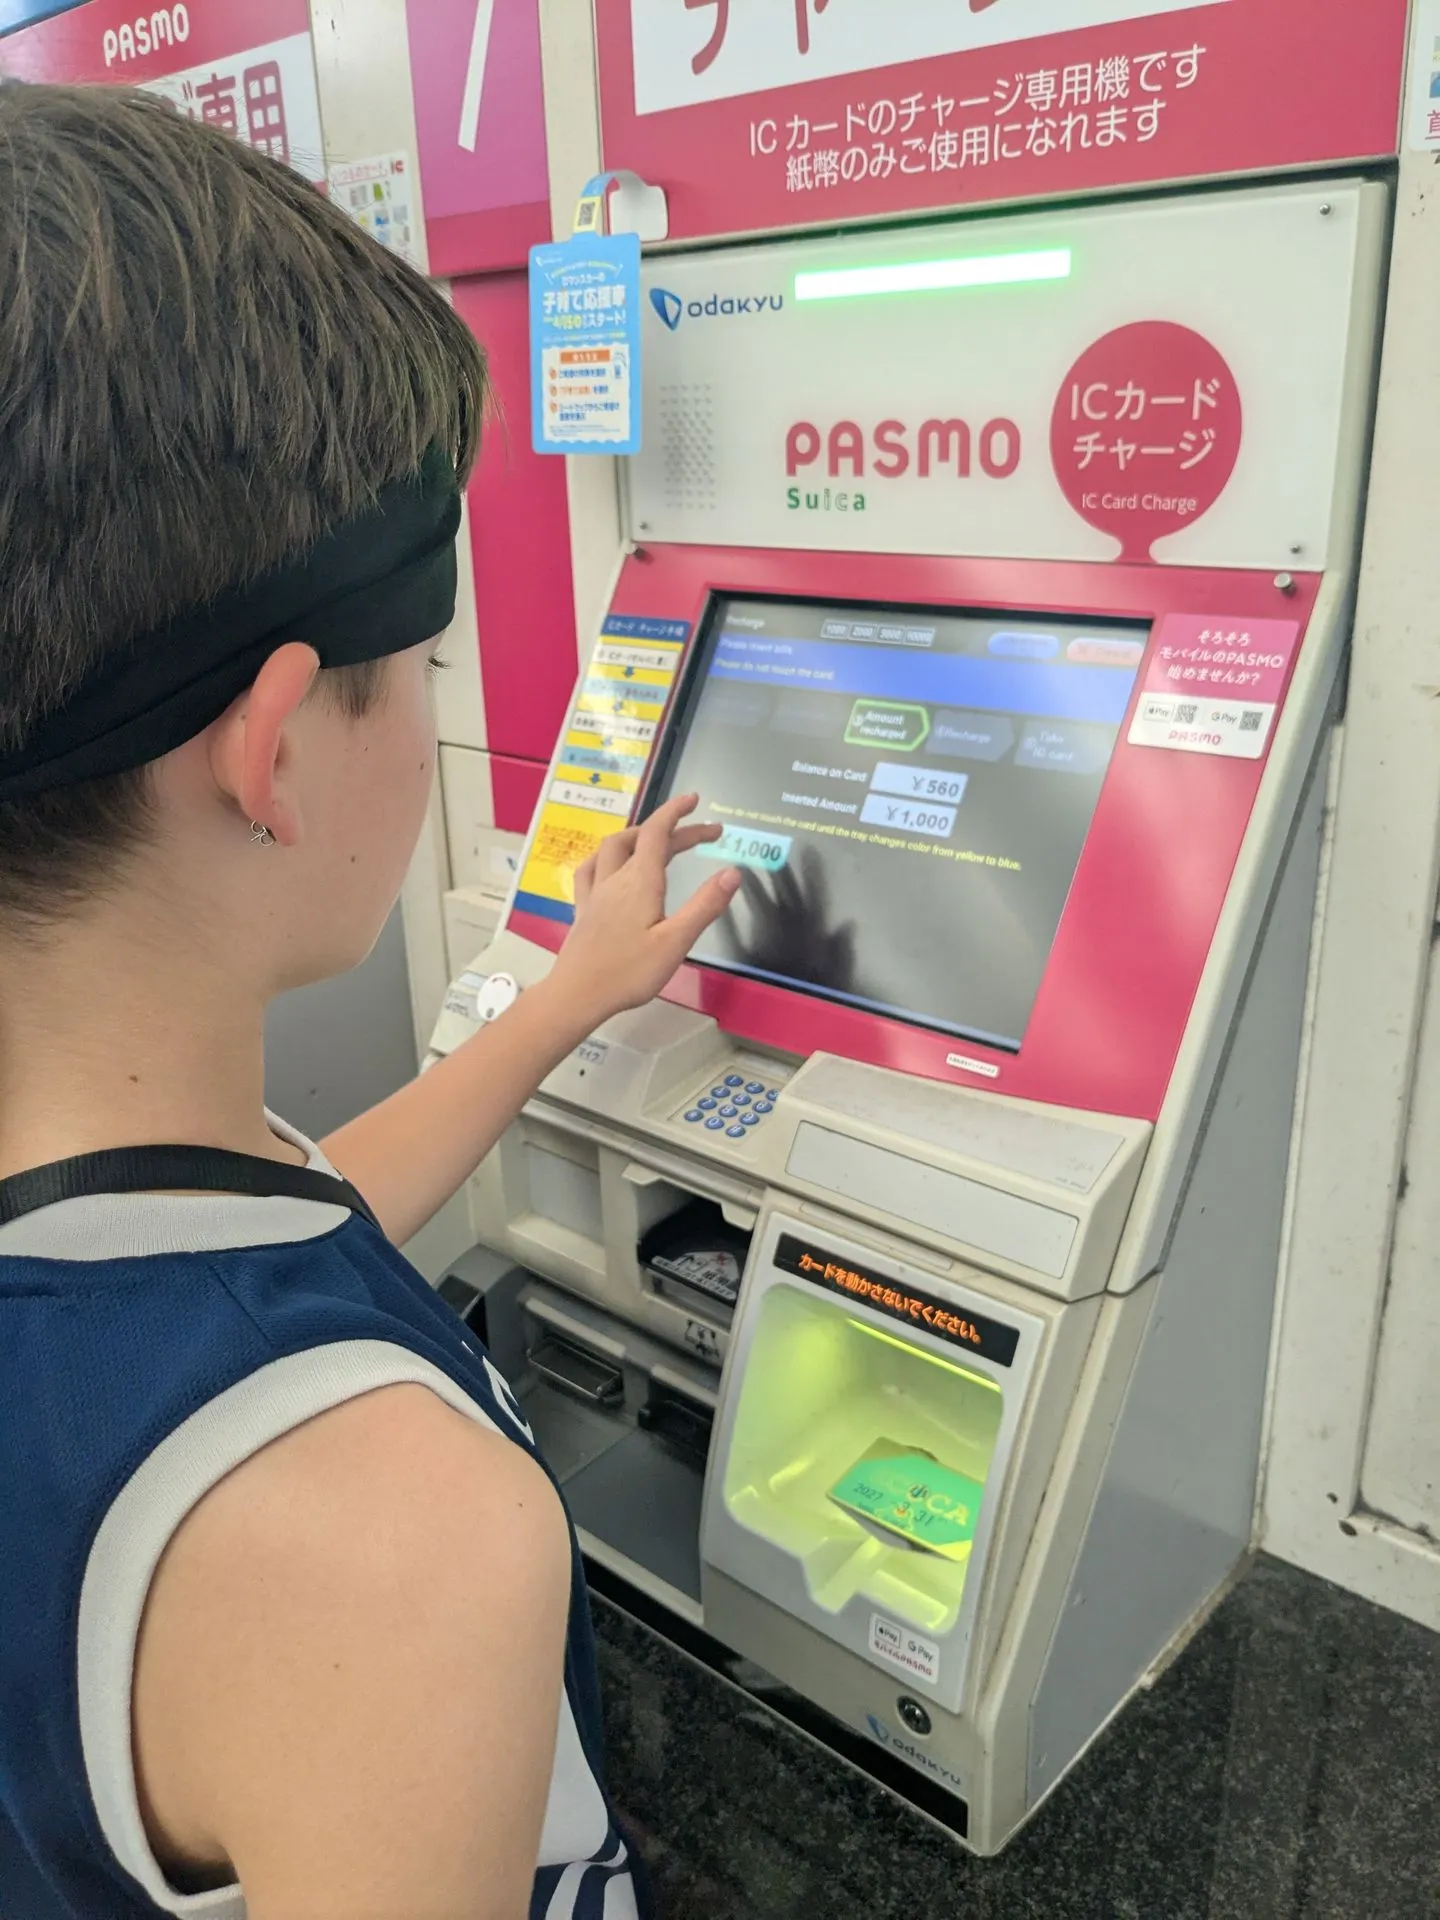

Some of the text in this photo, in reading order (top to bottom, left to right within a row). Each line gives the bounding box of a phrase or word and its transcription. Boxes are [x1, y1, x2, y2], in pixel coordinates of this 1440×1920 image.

[103, 3, 190, 67] PASMO
[786, 98, 1166, 193] 紙幣のみご使用になれます
[687, 293, 783, 317] odakyu
[1070, 378, 1221, 421] ICカード
[786, 417, 1021, 479] PASMO
[1072, 428, 1217, 471] チャージ
[787, 487, 865, 511] Suica
[1082, 493, 1196, 514] IC Card Charge
[1198, 629, 1251, 647] そろそろ
[715, 657, 740, 670] Please
[742, 661, 753, 671] do
[771, 664, 795, 676] touch
[797, 667, 812, 678] the
[1160, 646, 1284, 669] モバイルのPASMO
[865, 711, 904, 725] Amount
[1221, 712, 1238, 724] Pay
[859, 725, 907, 740] recharged
[1168, 729, 1223, 746] PASMO
[792, 759, 867, 782] Balance on Card
[781, 791, 858, 814] Inserted Amount
[760, 813, 782, 824] touch
[783, 817, 796, 828] the
[797, 821, 817, 832] card
[816, 824, 835, 835] until
[836, 827, 850, 838] the
[851, 830, 869, 842] tray
[869, 833, 906, 849] changes
[907, 841, 931, 854] color
[932, 844, 954, 857] from
[955, 850, 984, 864] yellow
[985, 855, 997, 866] to
[798, 1253, 982, 1345] カードを動かさないでください。
[853, 1482, 884, 1502] 2027
[917, 1646, 934, 1663] Pay
[893, 1737, 962, 1786] odakyu
